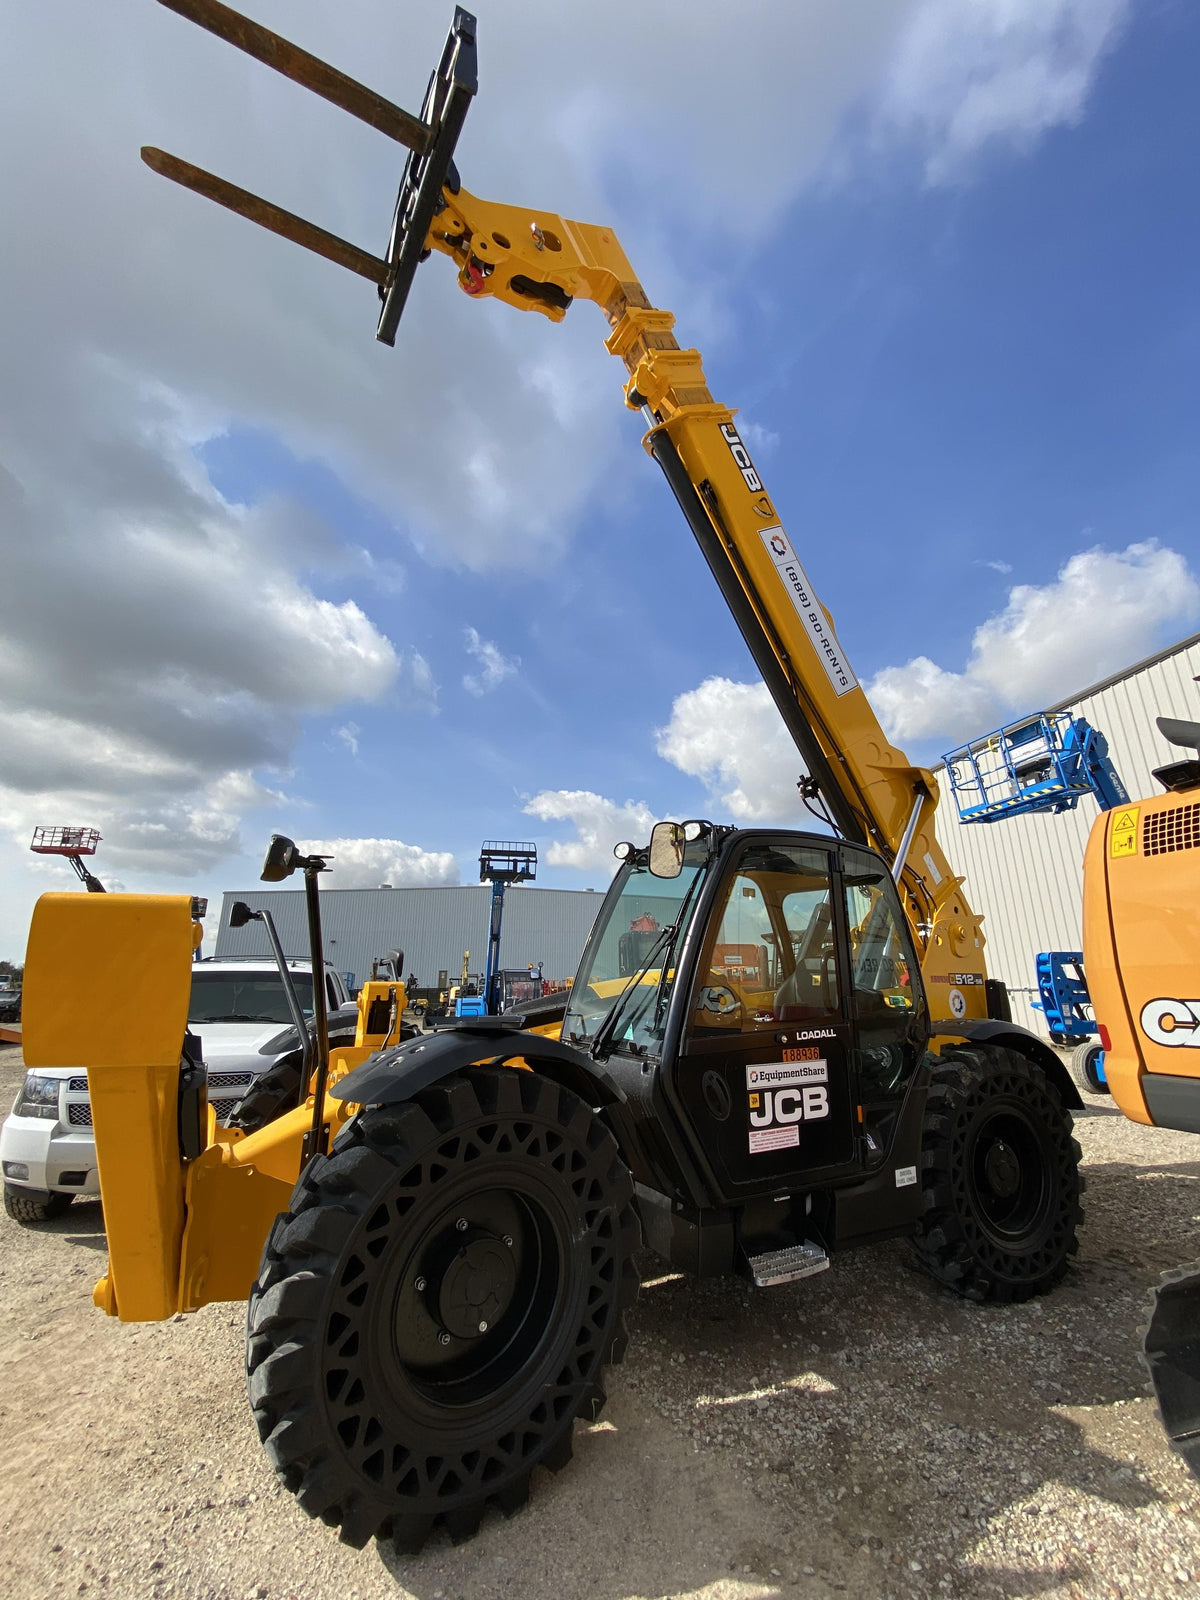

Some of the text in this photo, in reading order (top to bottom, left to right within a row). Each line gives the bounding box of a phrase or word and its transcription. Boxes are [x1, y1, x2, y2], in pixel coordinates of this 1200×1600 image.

[721, 425, 762, 492] JCB
[785, 566, 849, 687] (888) 80-RENTS
[1110, 771, 1126, 799] Genie
[796, 1028, 837, 1041] LOADALL
[783, 1047, 819, 1062] 188936
[759, 1067, 825, 1082] EquipmentShare
[749, 1086, 829, 1127] JCB
